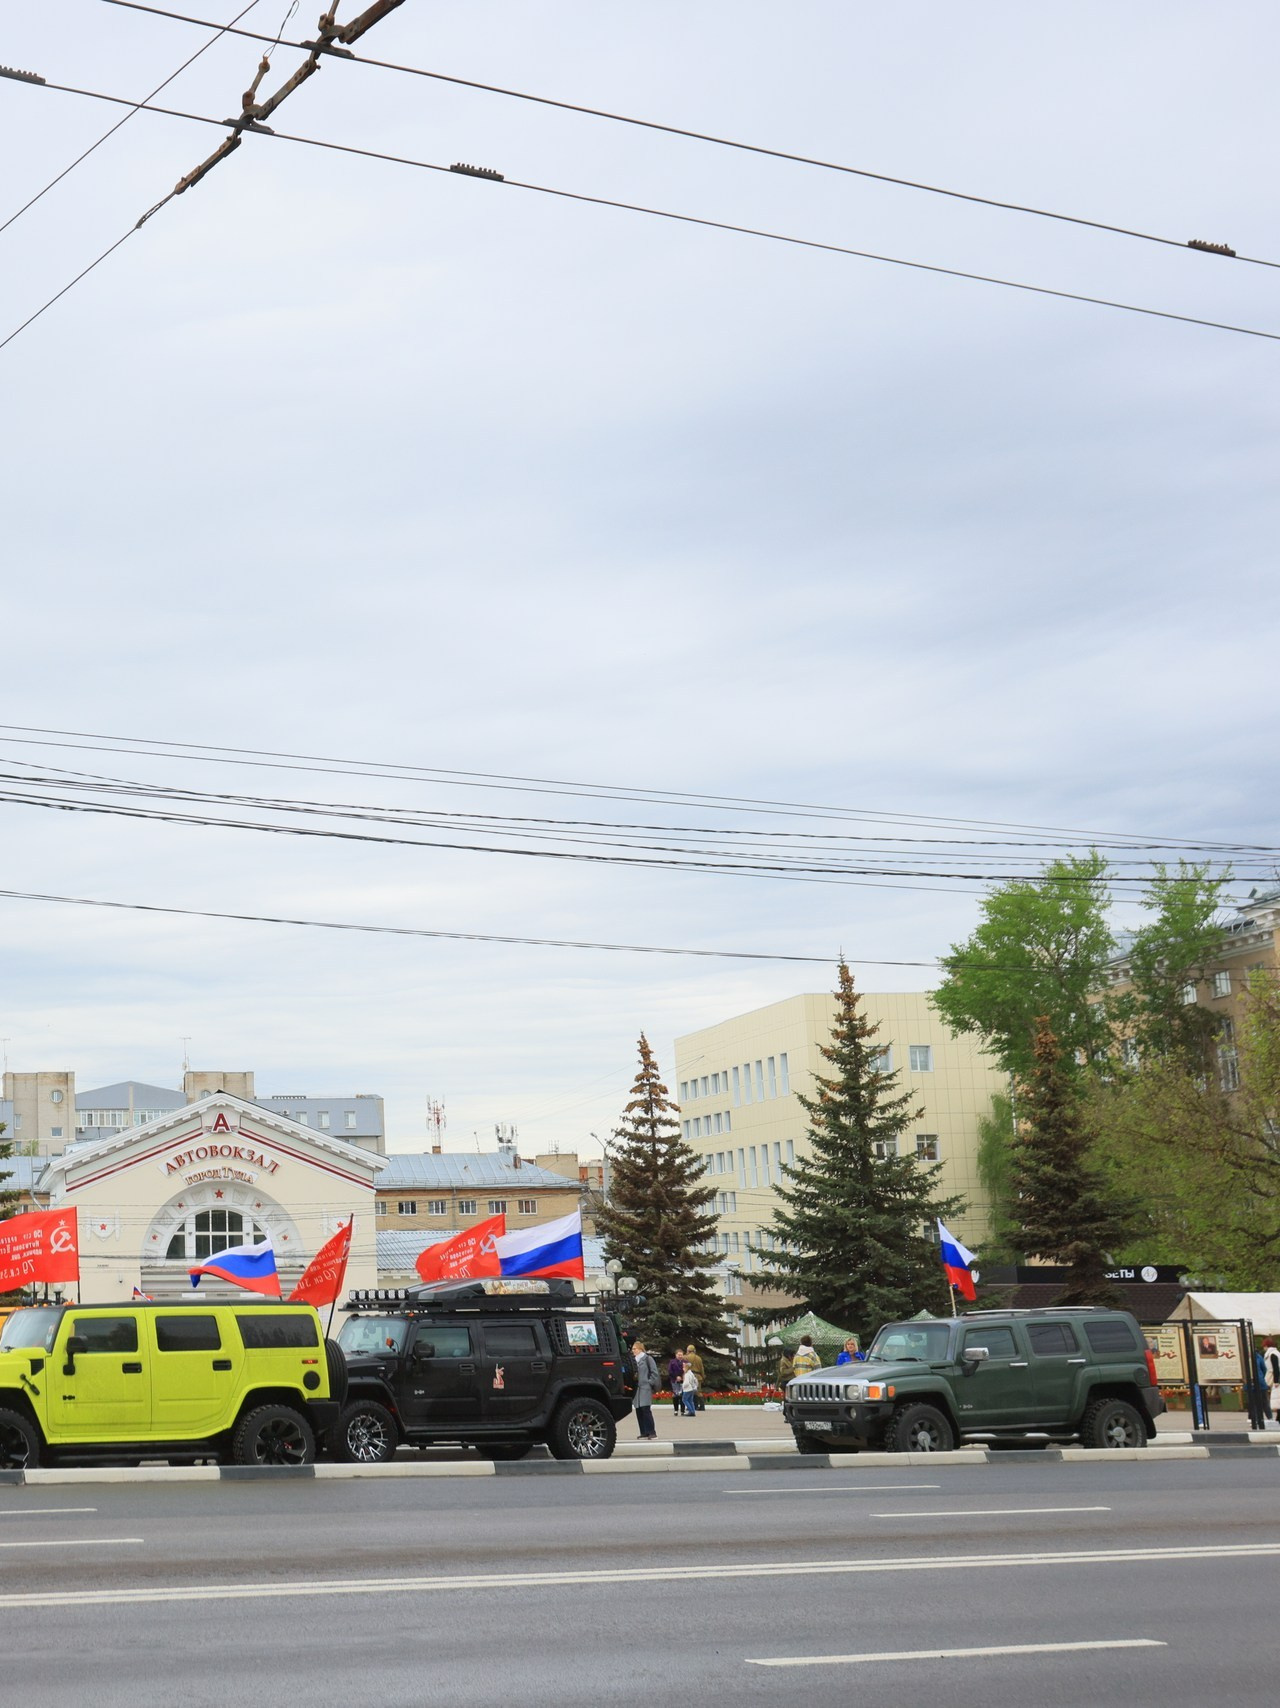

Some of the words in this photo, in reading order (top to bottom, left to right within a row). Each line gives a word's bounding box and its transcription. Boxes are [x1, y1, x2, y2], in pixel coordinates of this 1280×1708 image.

[213, 1113, 231, 1132] А
[165, 1144, 281, 1174] АВТОВОКЗАЛ
[185, 1168, 221, 1185] ГОРОД
